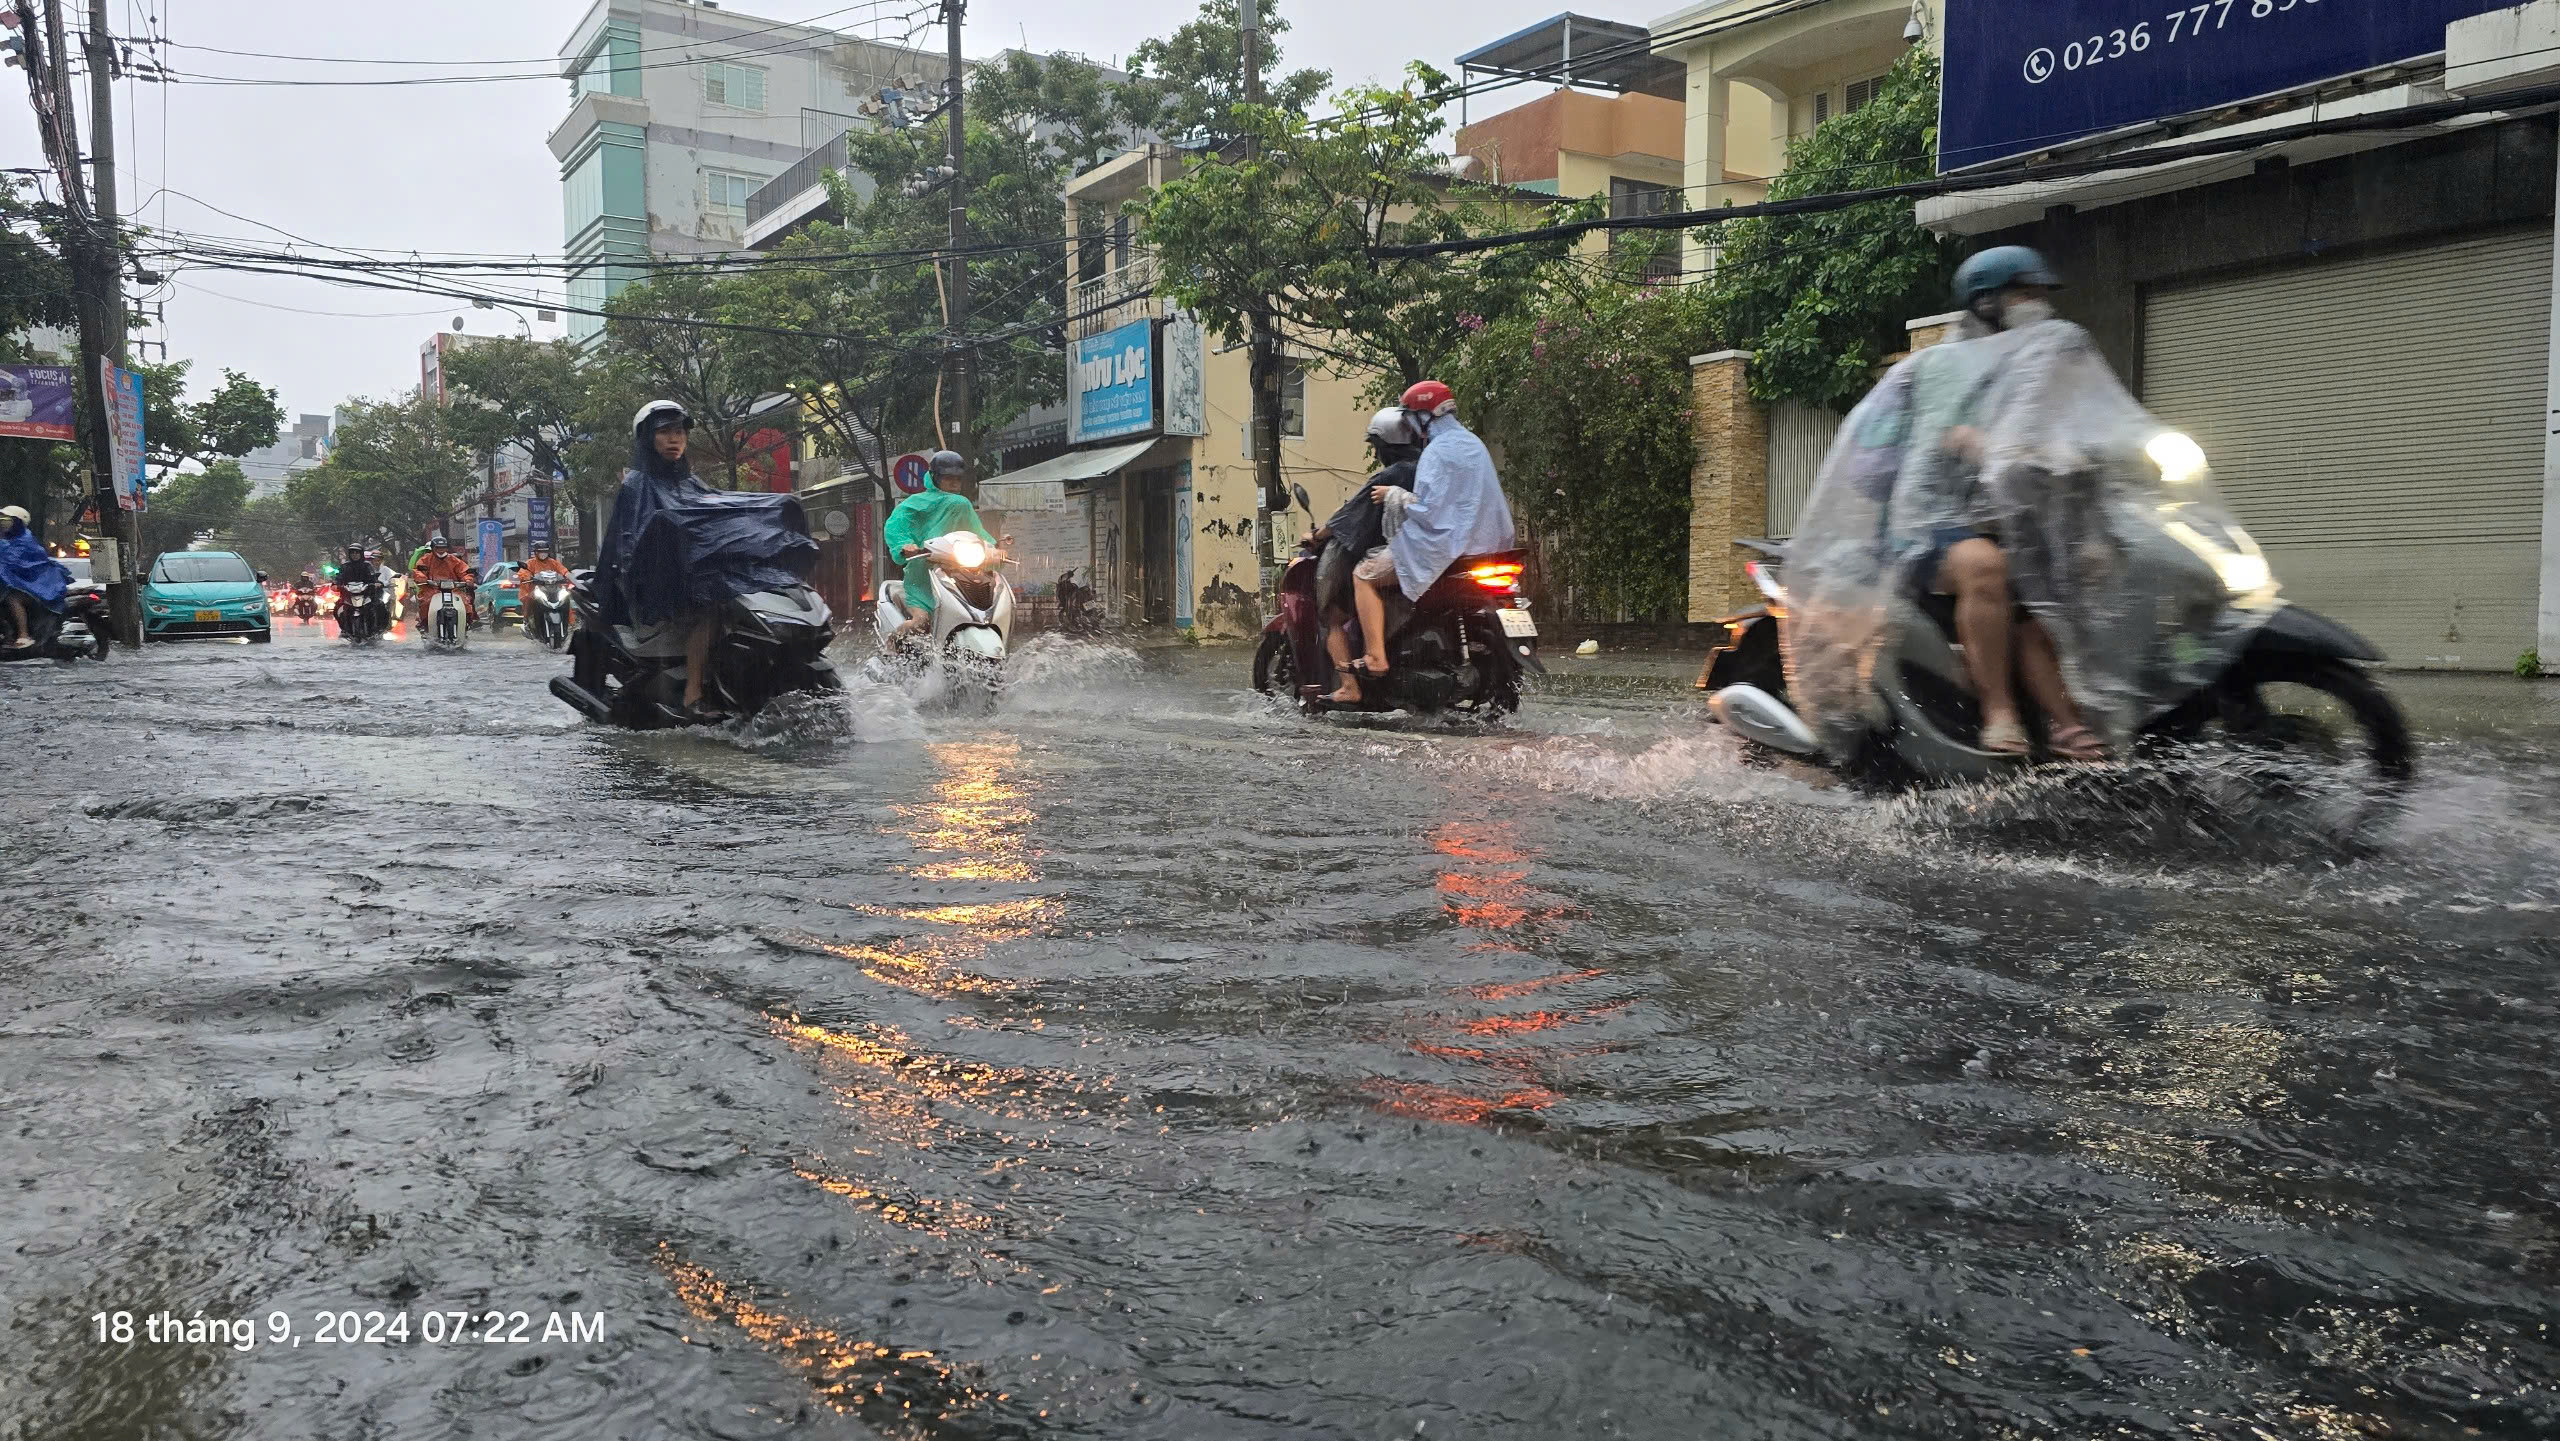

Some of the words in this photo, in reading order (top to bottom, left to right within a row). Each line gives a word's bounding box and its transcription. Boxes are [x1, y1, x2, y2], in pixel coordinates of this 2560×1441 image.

[2063, 21, 2151, 71] 0236
[2166, 0, 2234, 43] 777
[28, 369, 58, 381] FOCUS
[1115, 345, 1146, 388] LỘC
